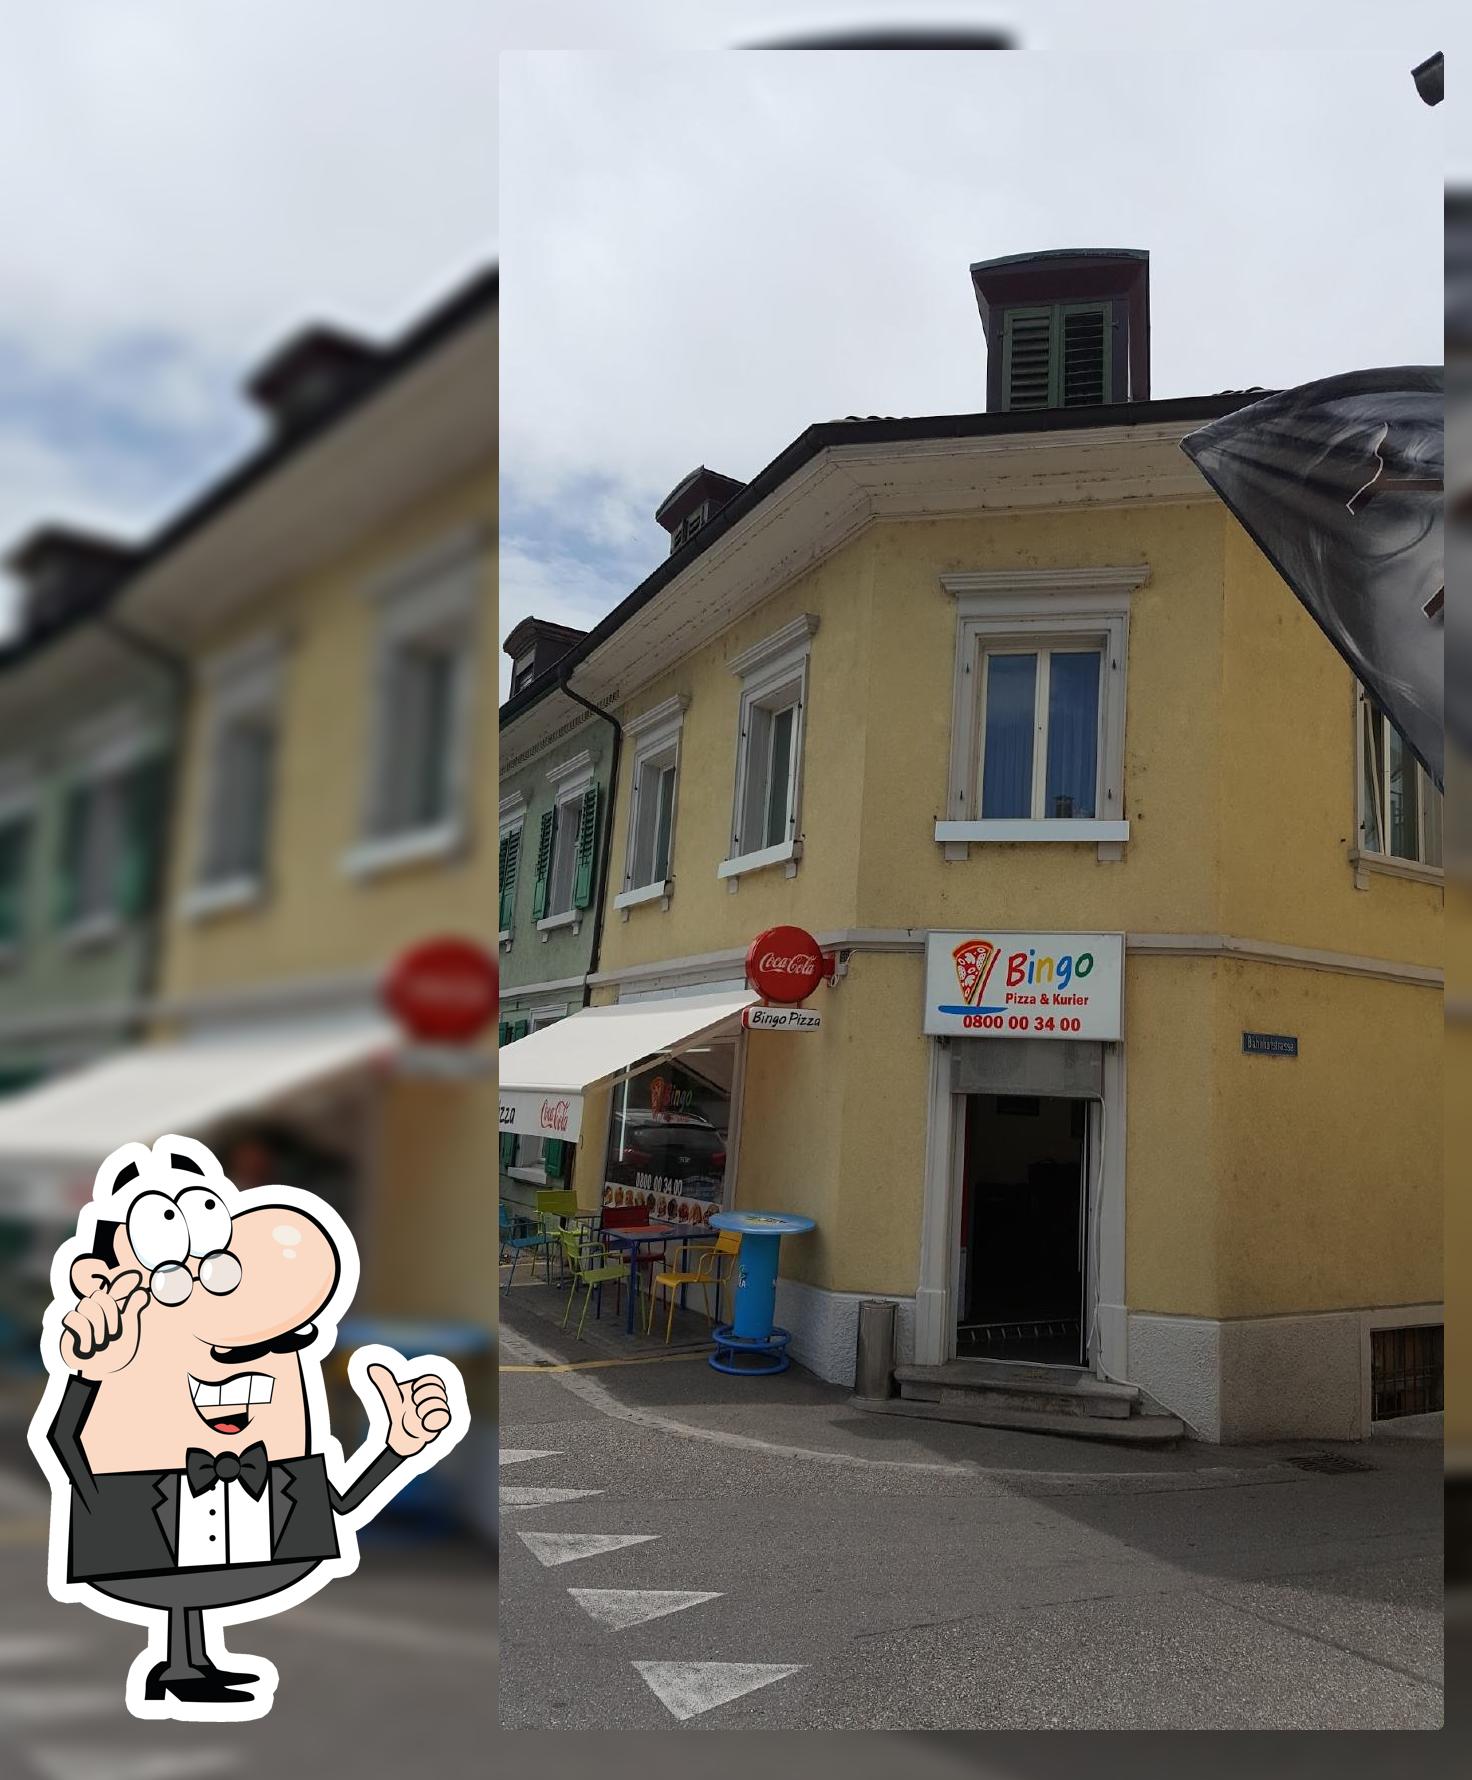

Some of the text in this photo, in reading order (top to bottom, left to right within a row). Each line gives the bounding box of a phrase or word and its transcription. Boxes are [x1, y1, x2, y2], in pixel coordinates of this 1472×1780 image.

[1006, 949, 1094, 990] Bingo
[1005, 993, 1089, 1006] Pizza & Kurier
[752, 1011, 821, 1027] Bingo Pizza
[963, 1015, 1081, 1031] 0800 00 34 00
[635, 1172, 683, 1196] 0800 00 34 00
